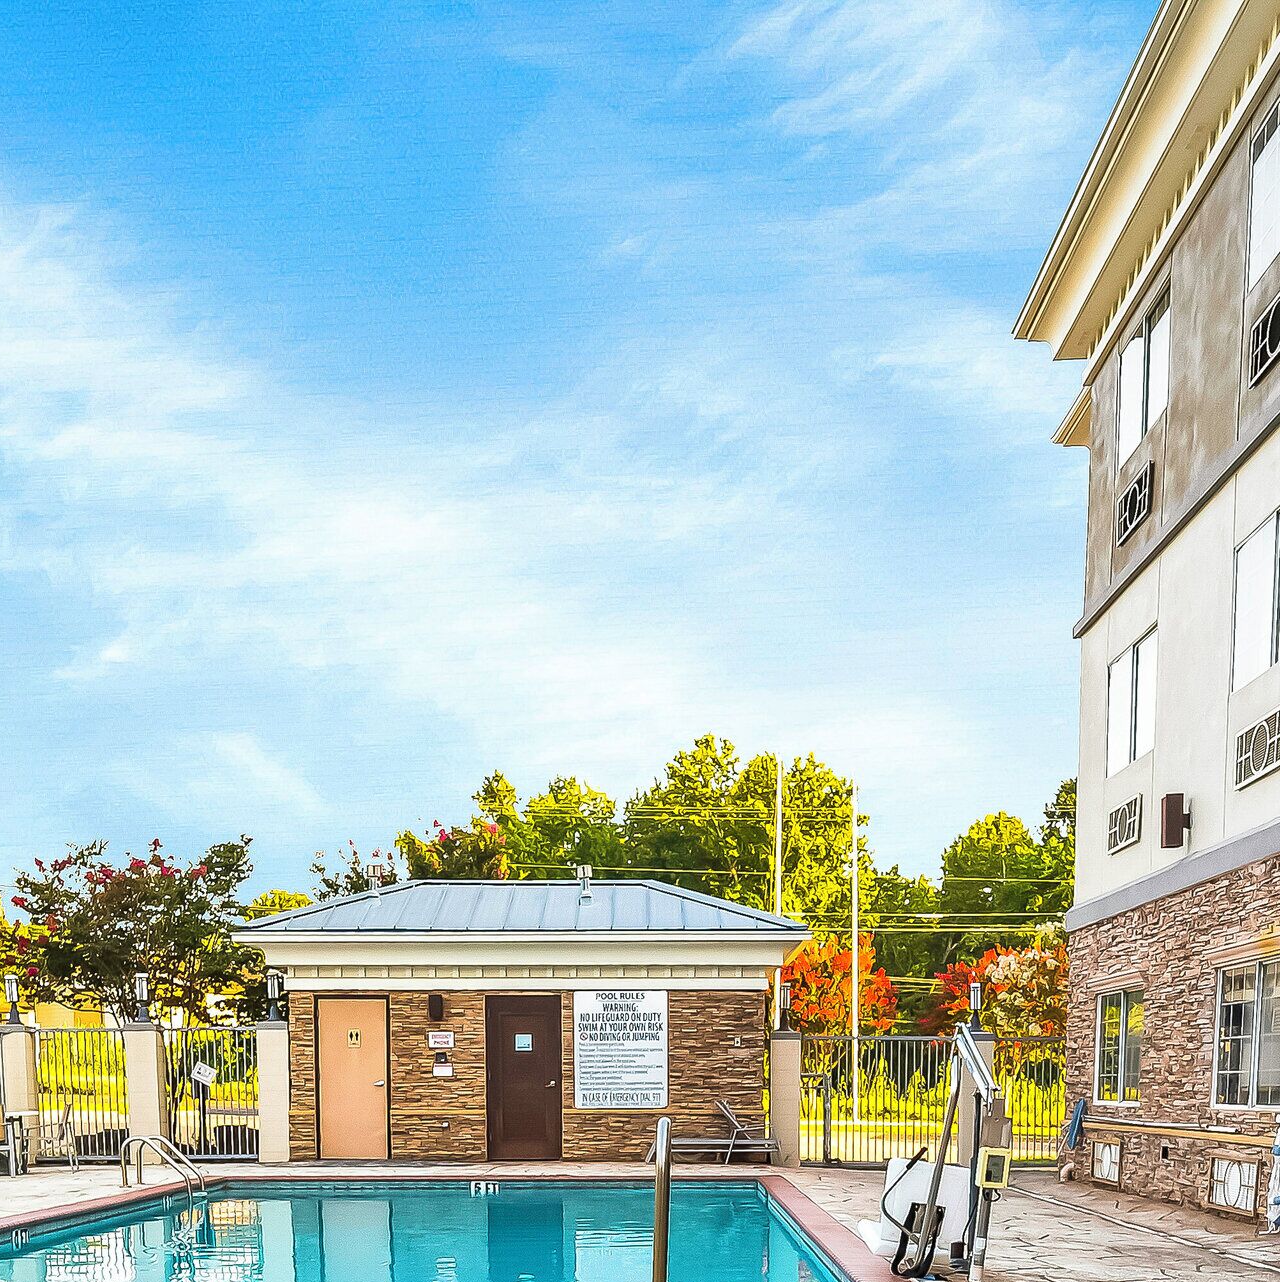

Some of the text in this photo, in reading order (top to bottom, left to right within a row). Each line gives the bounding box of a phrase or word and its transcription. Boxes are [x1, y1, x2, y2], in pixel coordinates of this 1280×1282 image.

[596, 992, 645, 1000] POOL RULES
[602, 1003, 638, 1012] WARNING:
[580, 1012, 661, 1022] NO LIFEGUARD ON DUTY
[578, 1022, 663, 1032] SWIM AT YOUR OWN RISK
[589, 1032, 659, 1041] NO DIVING OR JUMPING
[582, 1092, 661, 1102] IN CASE OF EMERGENCY DIAL 911
